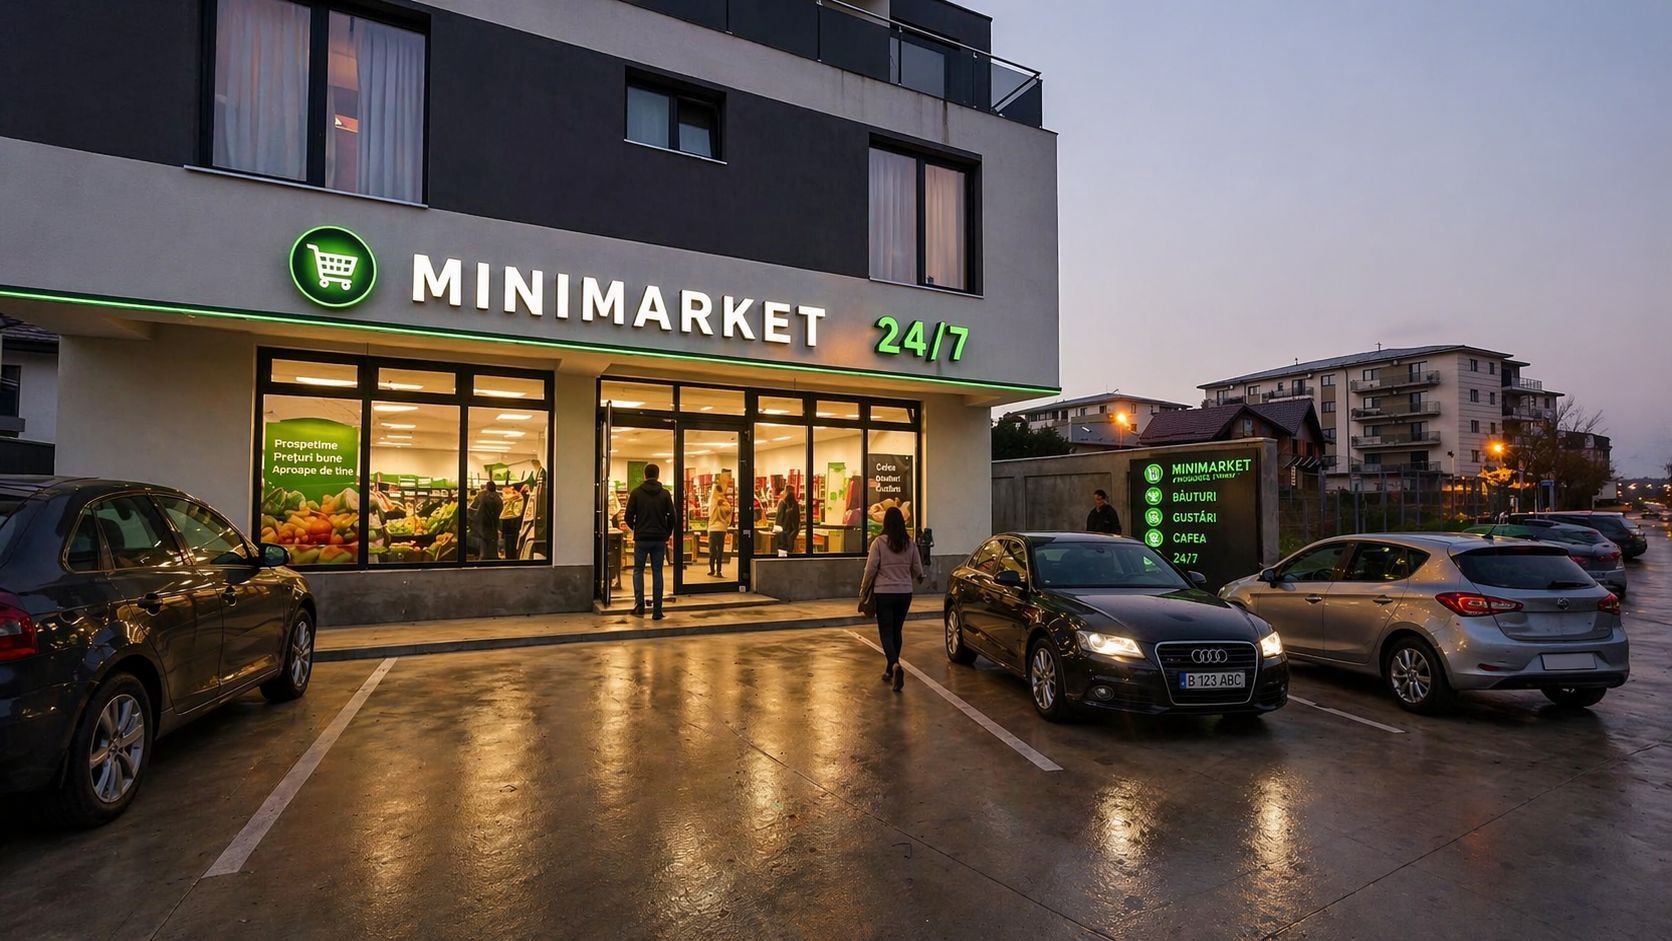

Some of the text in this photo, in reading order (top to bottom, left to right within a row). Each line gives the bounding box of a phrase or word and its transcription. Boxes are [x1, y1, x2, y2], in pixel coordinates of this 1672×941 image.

[411, 252, 970, 362] MINIMARKET 24/7
[274, 439, 338, 451] Prospetime
[316, 453, 343, 463] bune
[272, 465, 354, 476] Aproape de tine
[1172, 458, 1252, 475] MINIMARKET
[1172, 532, 1207, 543] CAFEA
[1173, 552, 1198, 564] 24/7
[1188, 673, 1242, 687] B 123 ABC
